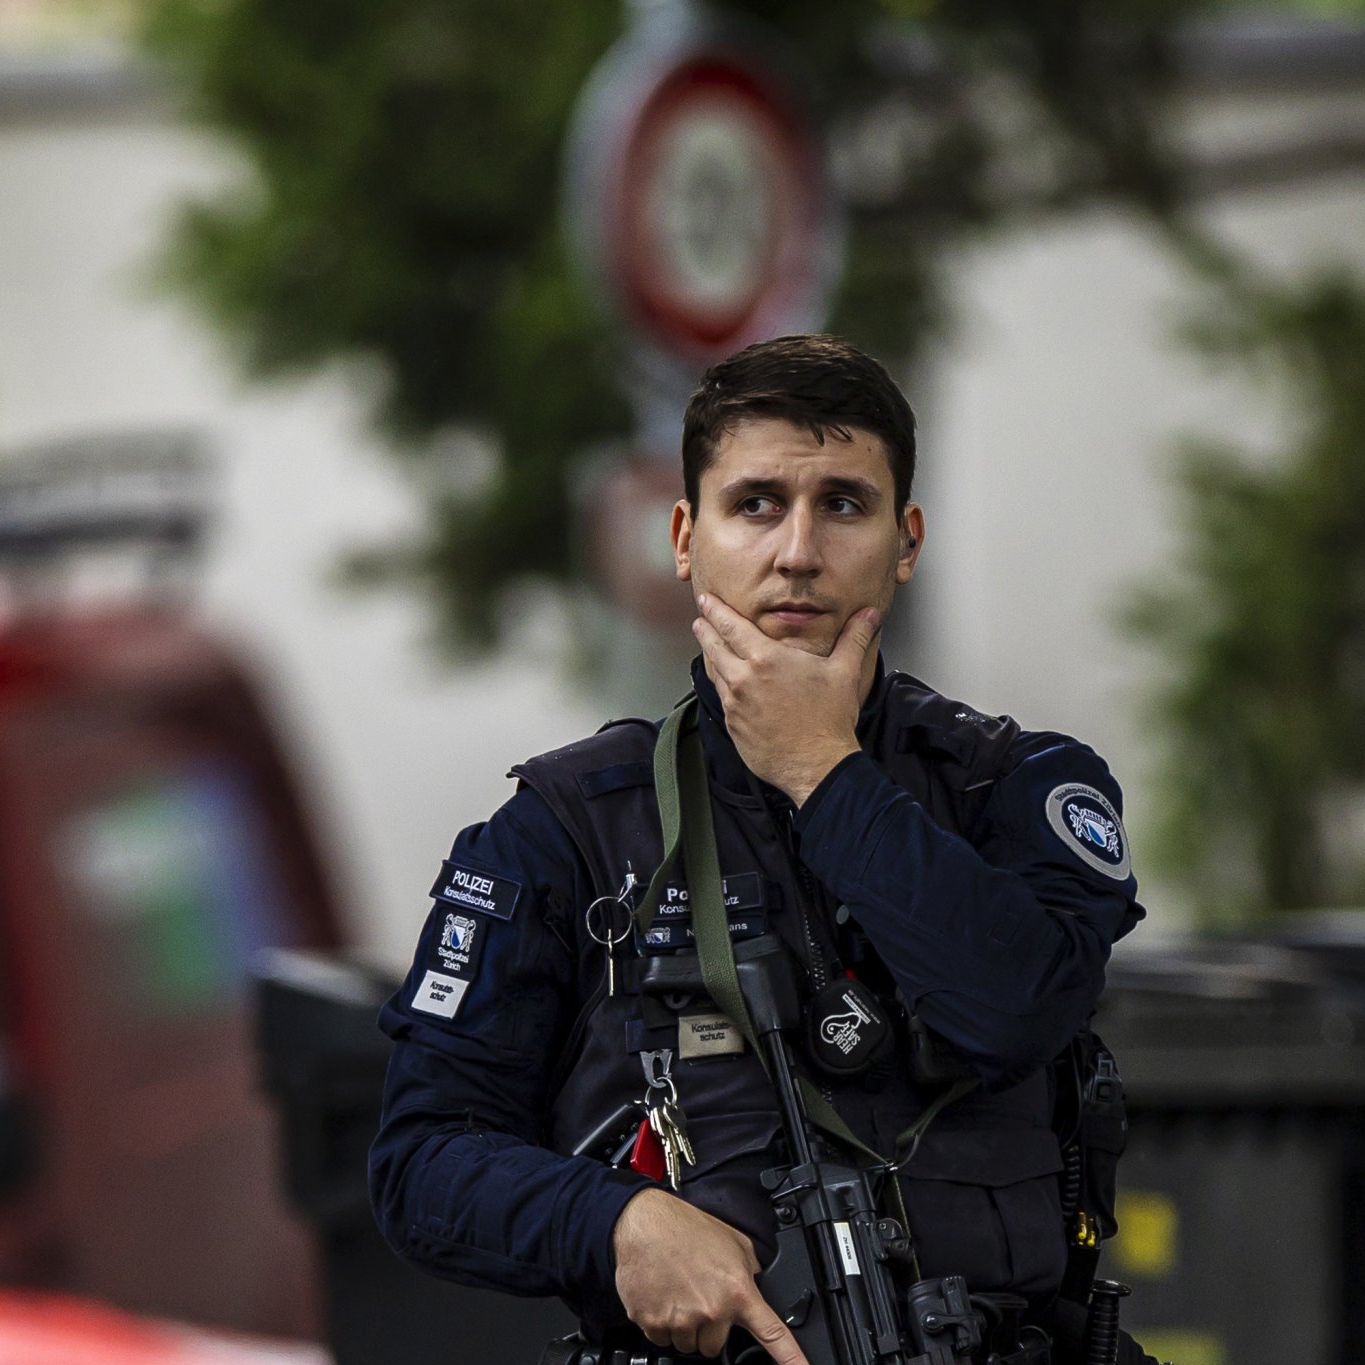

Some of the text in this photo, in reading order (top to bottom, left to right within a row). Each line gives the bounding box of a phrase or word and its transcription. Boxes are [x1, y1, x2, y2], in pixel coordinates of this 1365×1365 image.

[452, 870, 494, 895] POLIZEI
[833, 1030, 854, 1055] HEAR
[840, 1021, 861, 1046] SAFE
